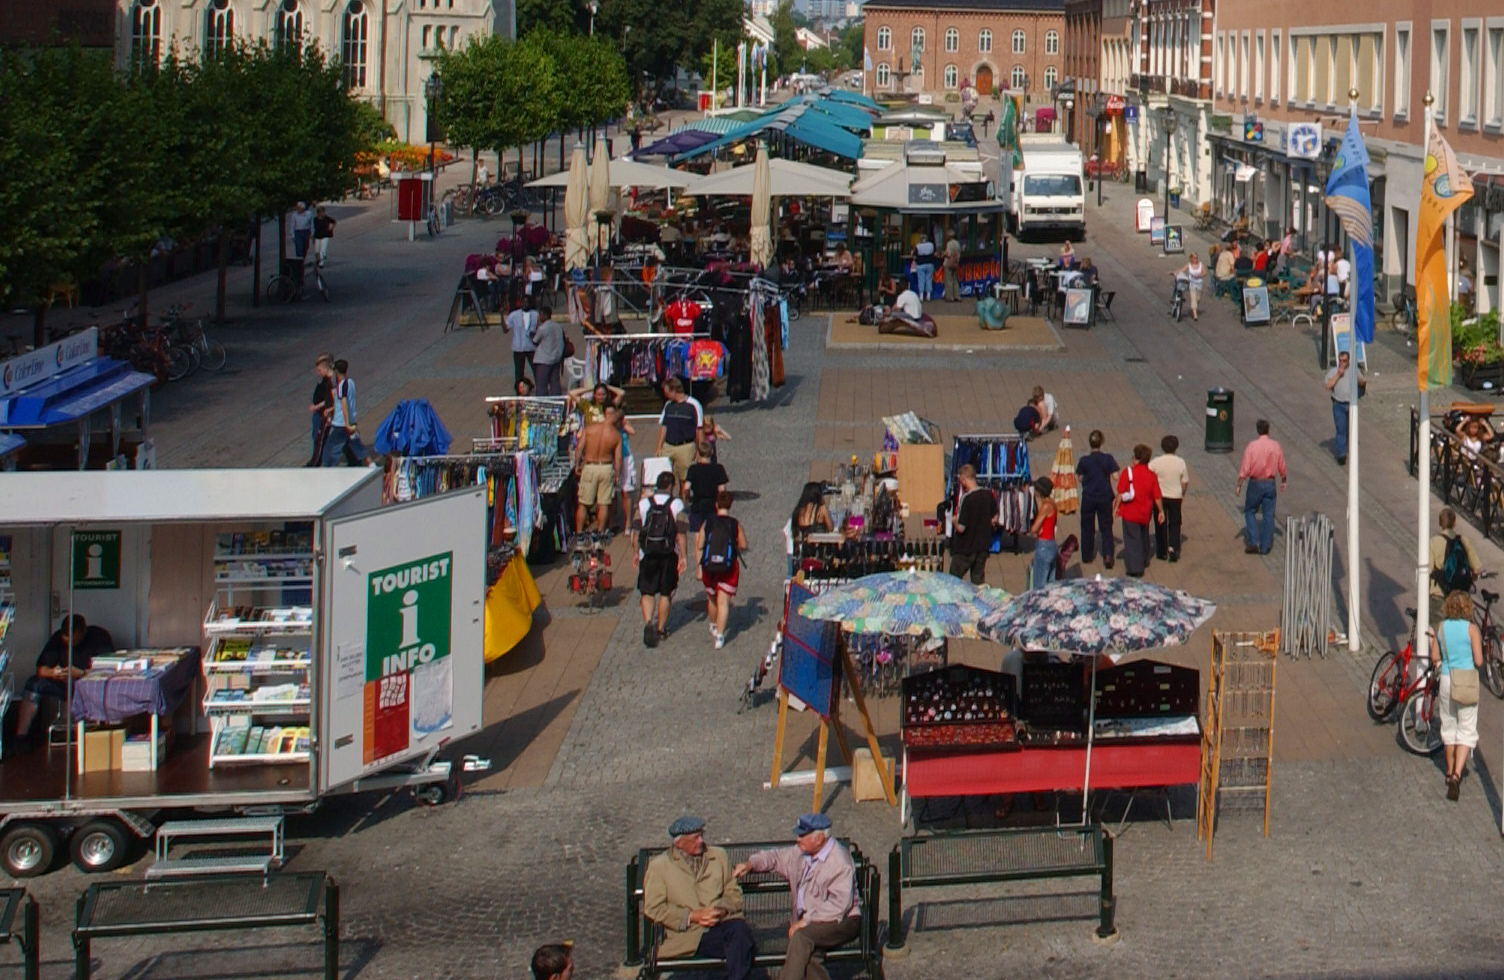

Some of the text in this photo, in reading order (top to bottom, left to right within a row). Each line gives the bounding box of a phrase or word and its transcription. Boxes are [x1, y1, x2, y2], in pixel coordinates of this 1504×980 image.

[75, 533, 118, 541] TOURIST
[371, 557, 450, 596] TOURIST
[382, 642, 436, 678] INFO
